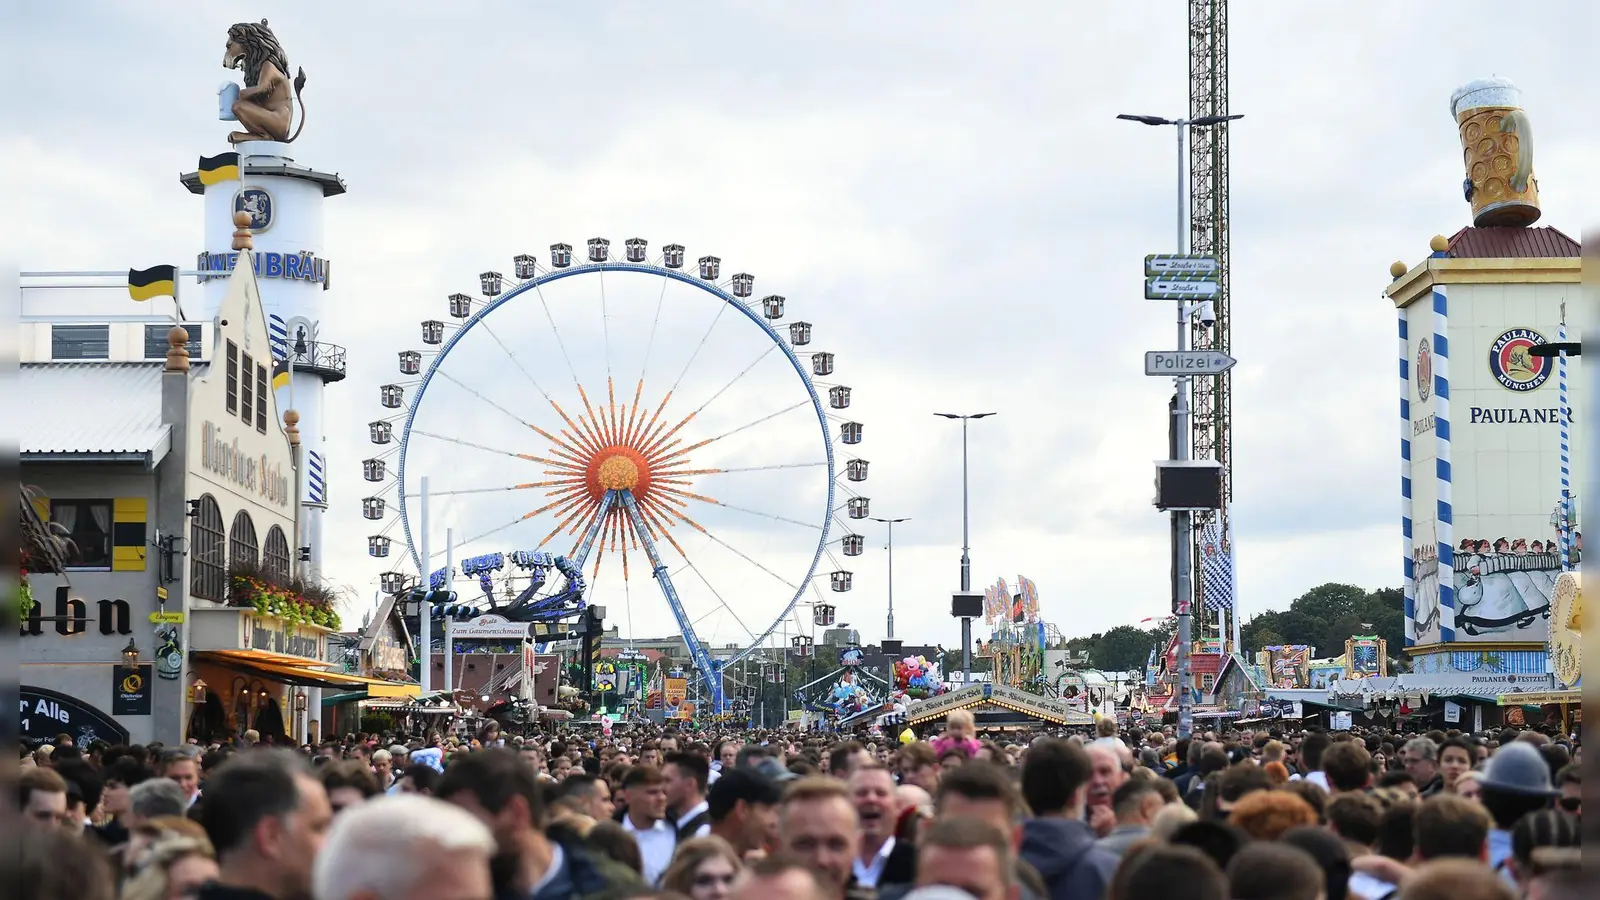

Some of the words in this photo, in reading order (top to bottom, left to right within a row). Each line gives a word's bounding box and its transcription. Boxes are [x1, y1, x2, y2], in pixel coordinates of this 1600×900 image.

[1491, 330, 1547, 354] PAULANE
[1155, 355, 1210, 369] Polizei
[1413, 411, 1436, 437] PAULANE
[35, 698, 70, 724] Alle
